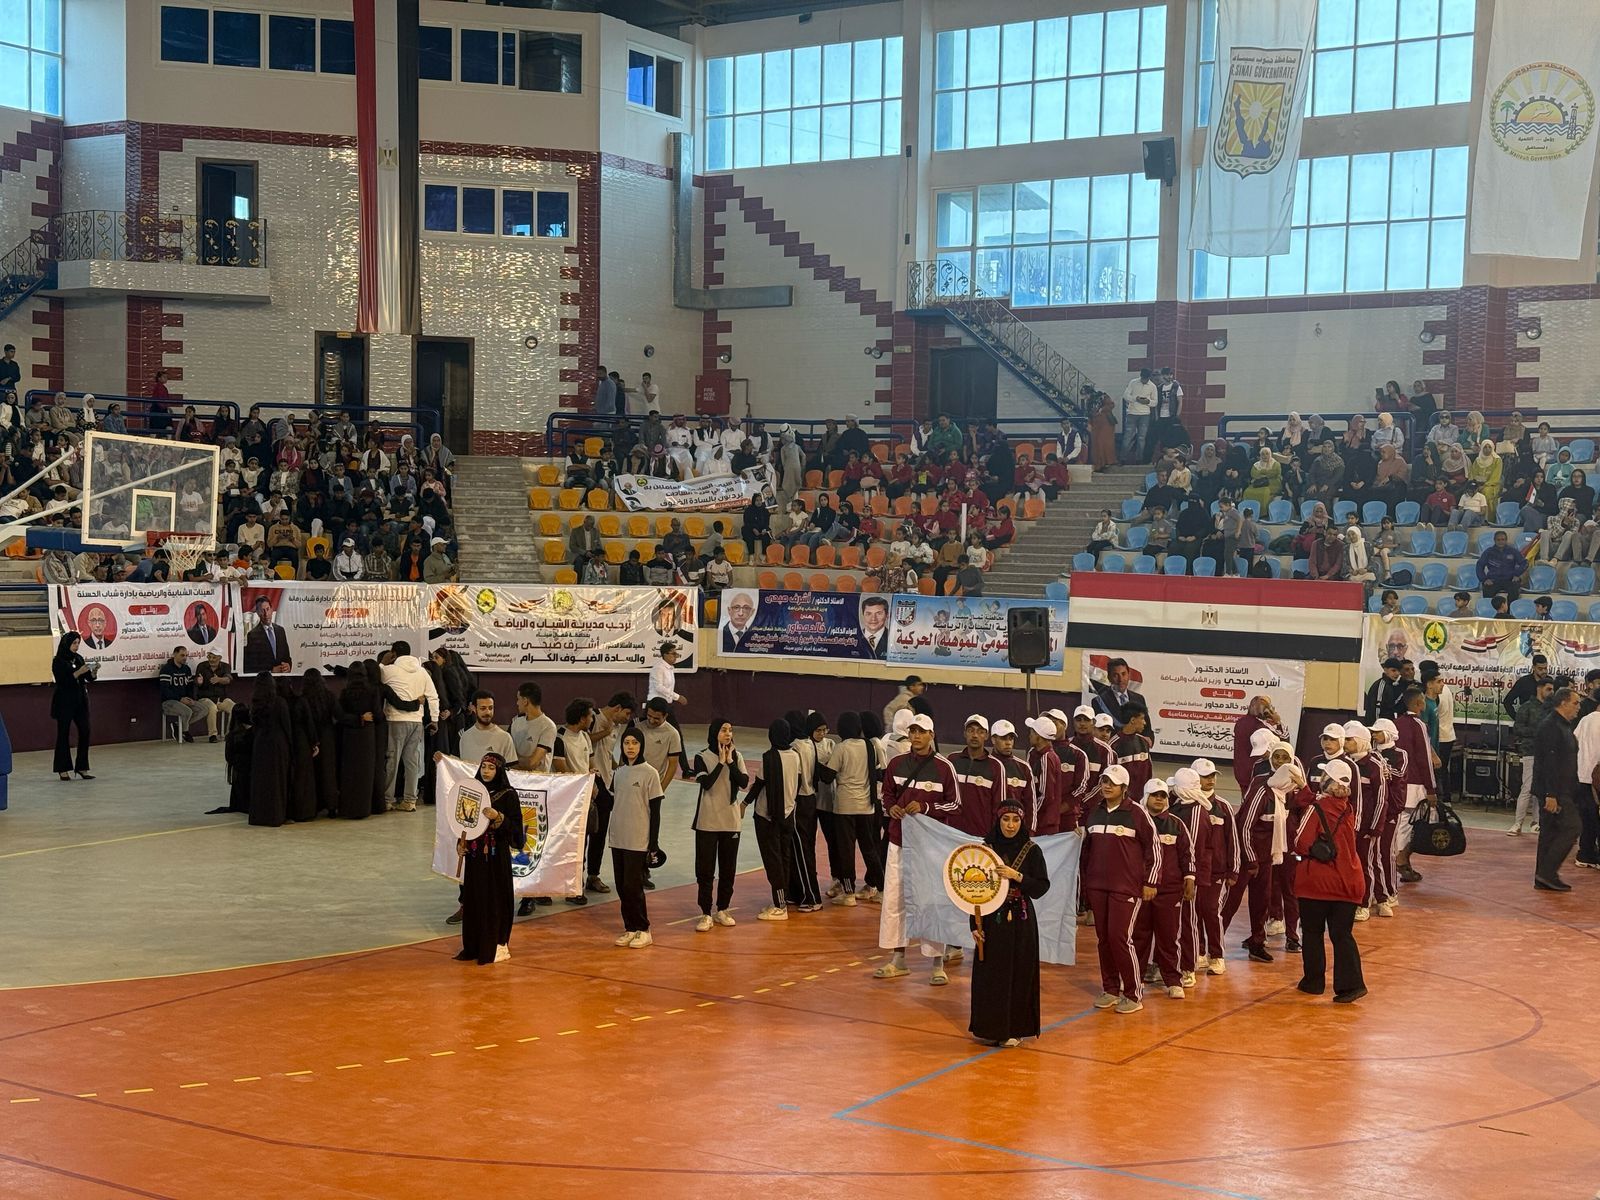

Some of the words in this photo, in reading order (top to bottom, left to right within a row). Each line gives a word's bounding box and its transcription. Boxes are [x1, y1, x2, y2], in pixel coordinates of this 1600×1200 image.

[896, 628, 937, 650] الحركية
[519, 653, 558, 665] الكرام
[1194, 665, 1224, 675] الدكتور
[1223, 677, 1254, 688] صبحي
[1255, 676, 1281, 689] أشرف
[1213, 743, 1235, 753] رياضية
[518, 791, 539, 800] محافظ
